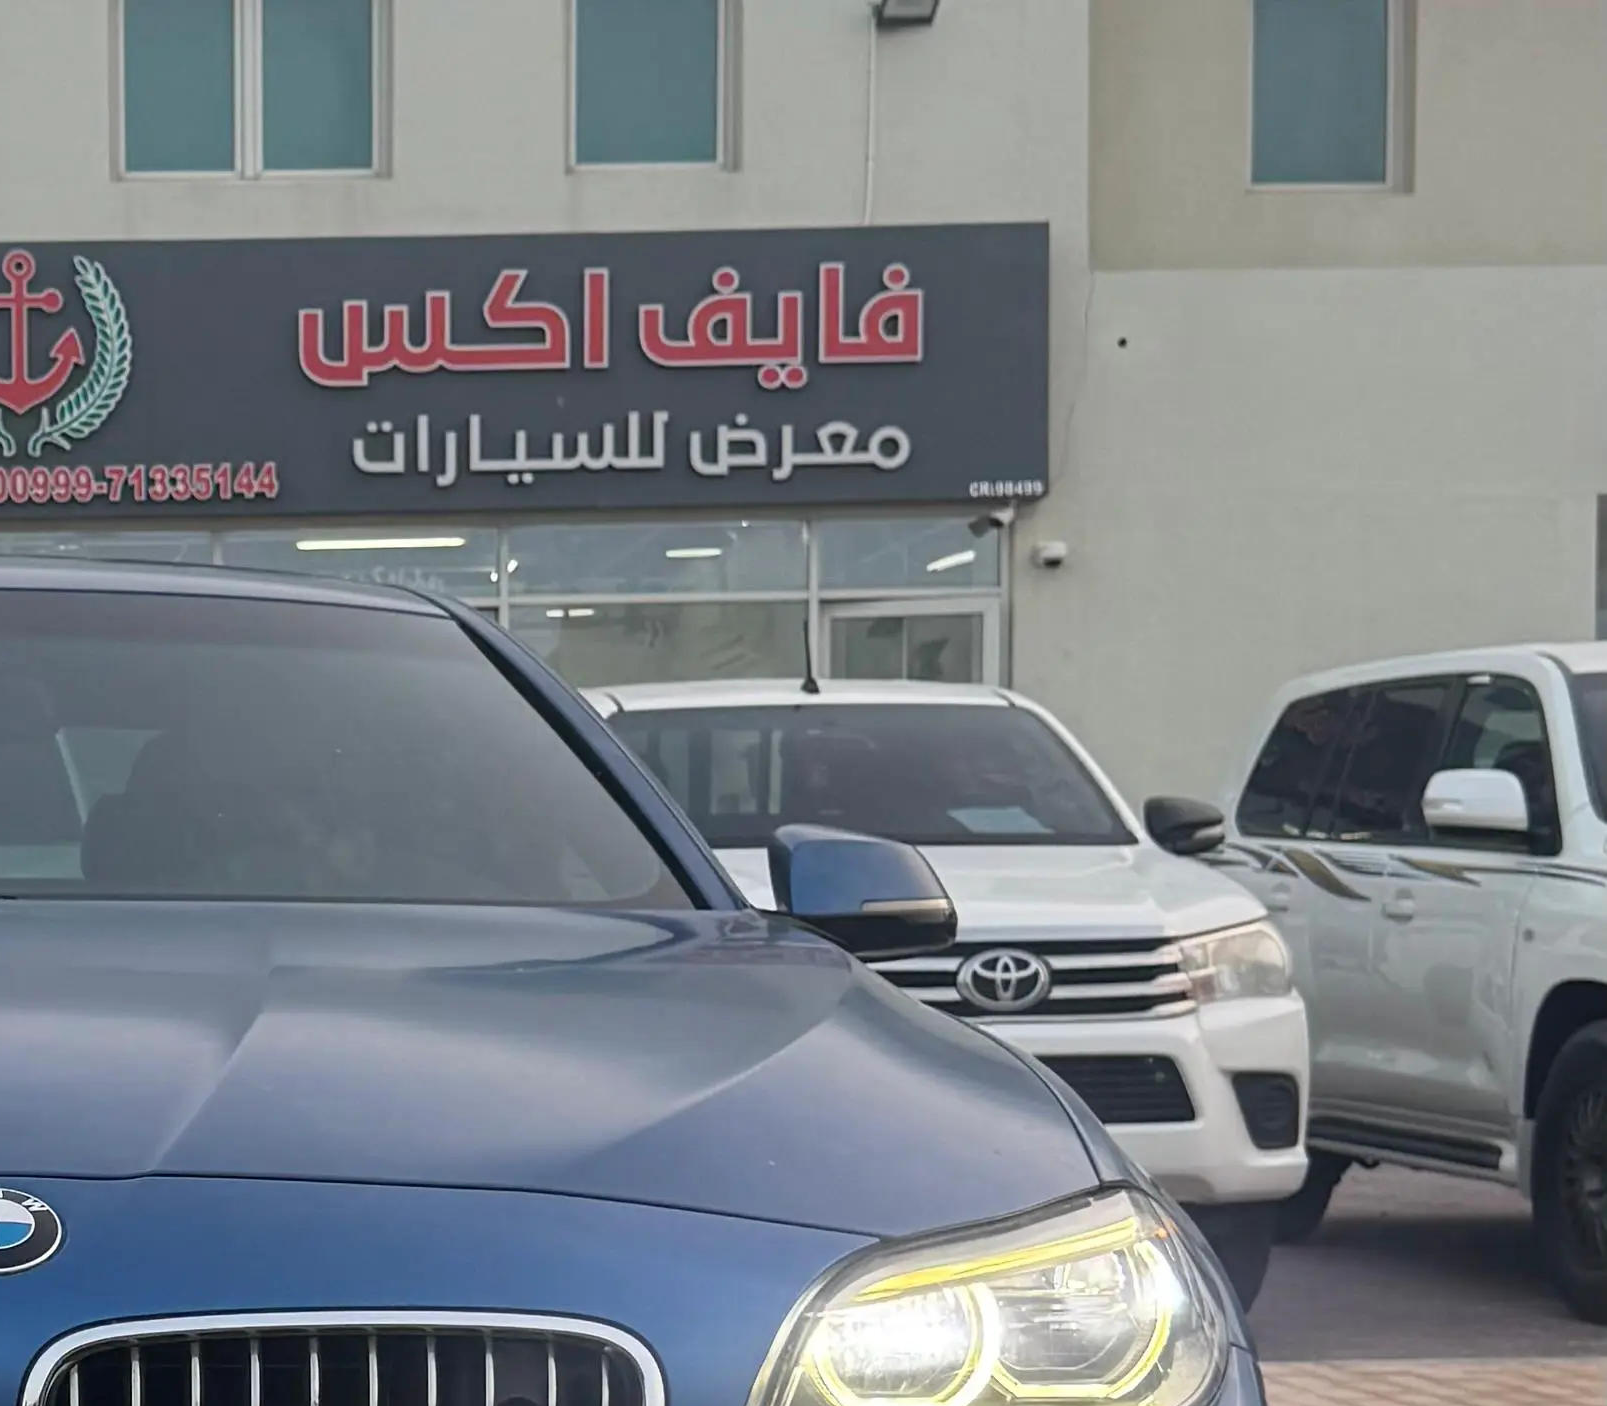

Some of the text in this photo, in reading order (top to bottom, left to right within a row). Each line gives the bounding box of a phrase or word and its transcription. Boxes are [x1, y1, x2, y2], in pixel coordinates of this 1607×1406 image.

[298, 262, 924, 389] فايف اكس
[353, 411, 911, 486] معرض للسيارات
